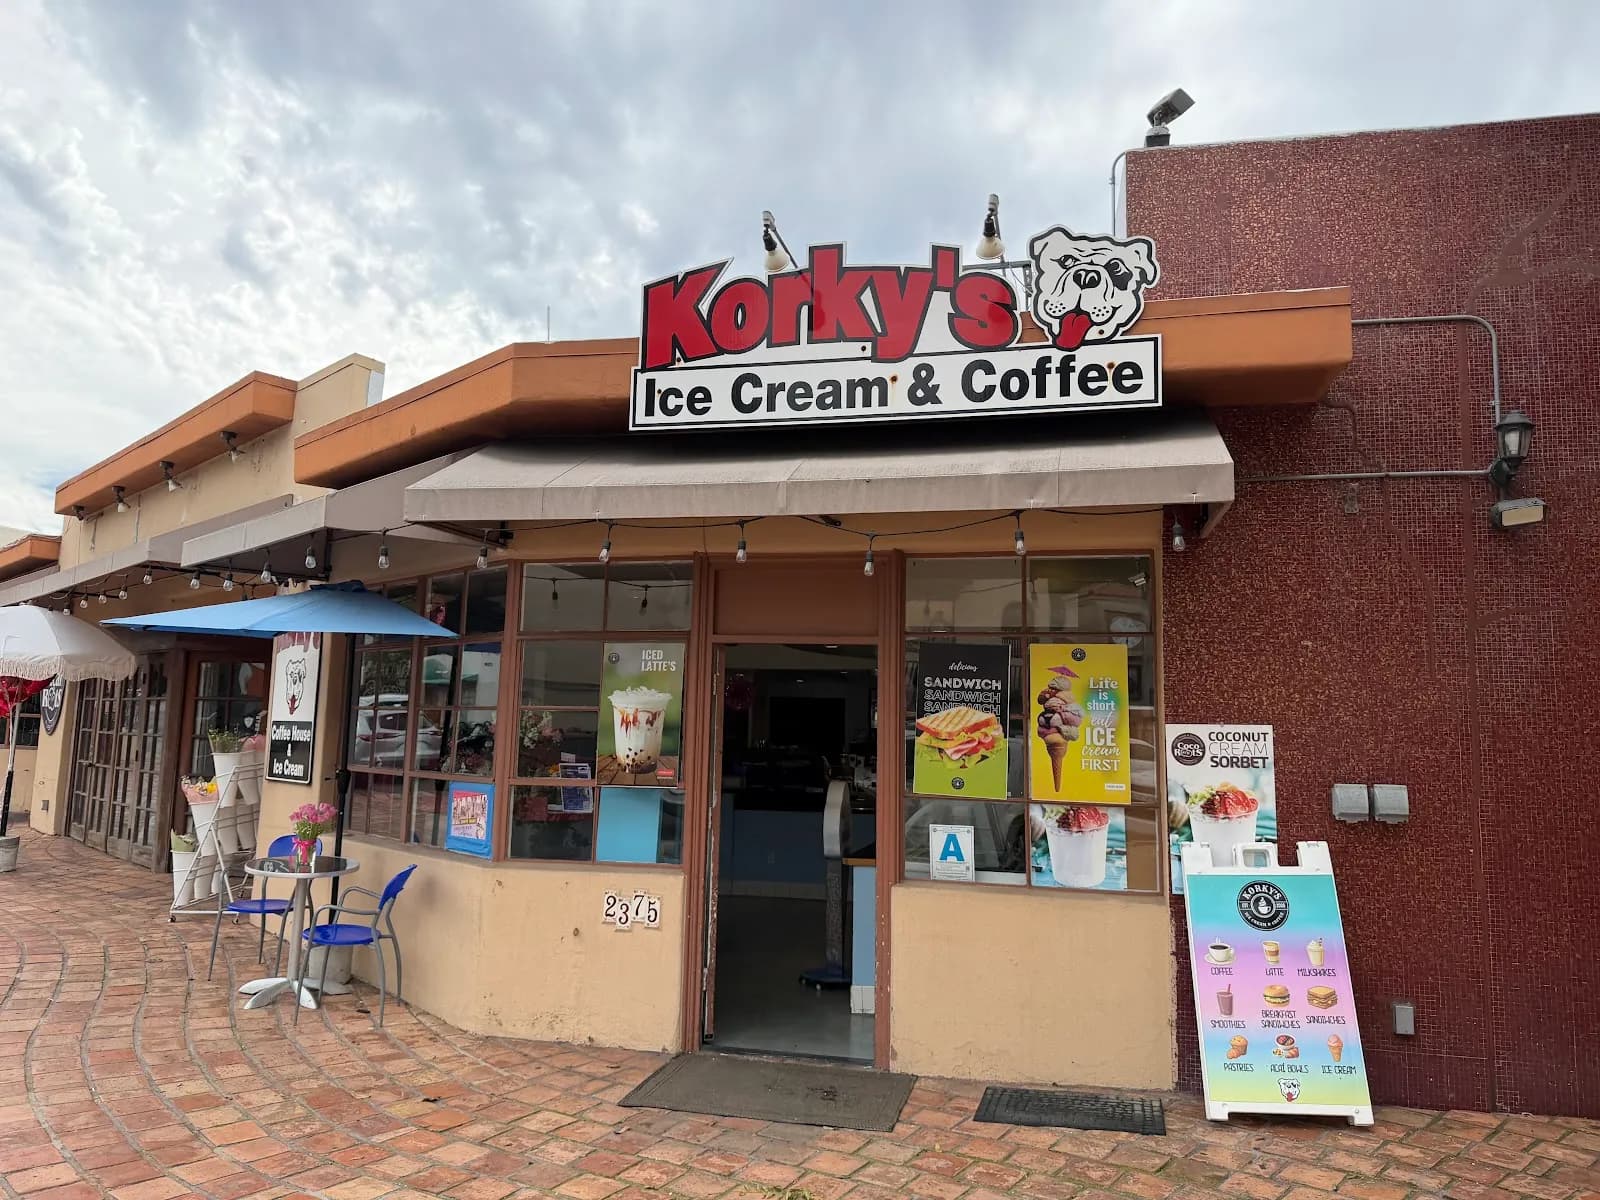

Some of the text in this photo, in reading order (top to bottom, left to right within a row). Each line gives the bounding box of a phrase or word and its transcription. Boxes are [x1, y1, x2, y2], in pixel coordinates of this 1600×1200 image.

[641, 244, 1019, 373] Korky's
[645, 354, 1144, 417] Ice Cream & Coffee
[641, 649, 676, 672] ICED LATTE'S
[948, 661, 979, 672] delicious
[924, 676, 1001, 690] SANDWICH
[1089, 677, 1119, 689] Life
[923, 688, 1001, 703] SANDWICH
[1098, 689, 1109, 700] is
[1087, 699, 1116, 711] short
[1090, 711, 1113, 728] eat
[271, 724, 311, 742] Coffee House
[1085, 727, 1116, 746] ICE
[1208, 731, 1269, 742] COCONUT
[1208, 742, 1268, 756] CREAM
[273, 758, 304, 777] Ice Cream
[1081, 758, 1121, 771] FIRST
[1210, 756, 1269, 768] SORBET
[939, 833, 965, 862] A
[1242, 884, 1283, 900] KORKY'S
[604, 895, 658, 925] 2375
[1210, 967, 1234, 976] COFFEE
[1265, 967, 1285, 977] LATTE
[1297, 968, 1337, 977] MILKSHAKES
[1261, 1009, 1297, 1019] BREAKFAST
[1305, 1015, 1346, 1025] SANDWICHES
[1210, 1019, 1247, 1029] SMOOTHIES
[1261, 1019, 1301, 1029] SANDWICHES
[1223, 1063, 1255, 1072] PASTRIES
[1287, 1064, 1310, 1074] BOWLS
[1321, 1065, 1357, 1075] ICE CREAM
